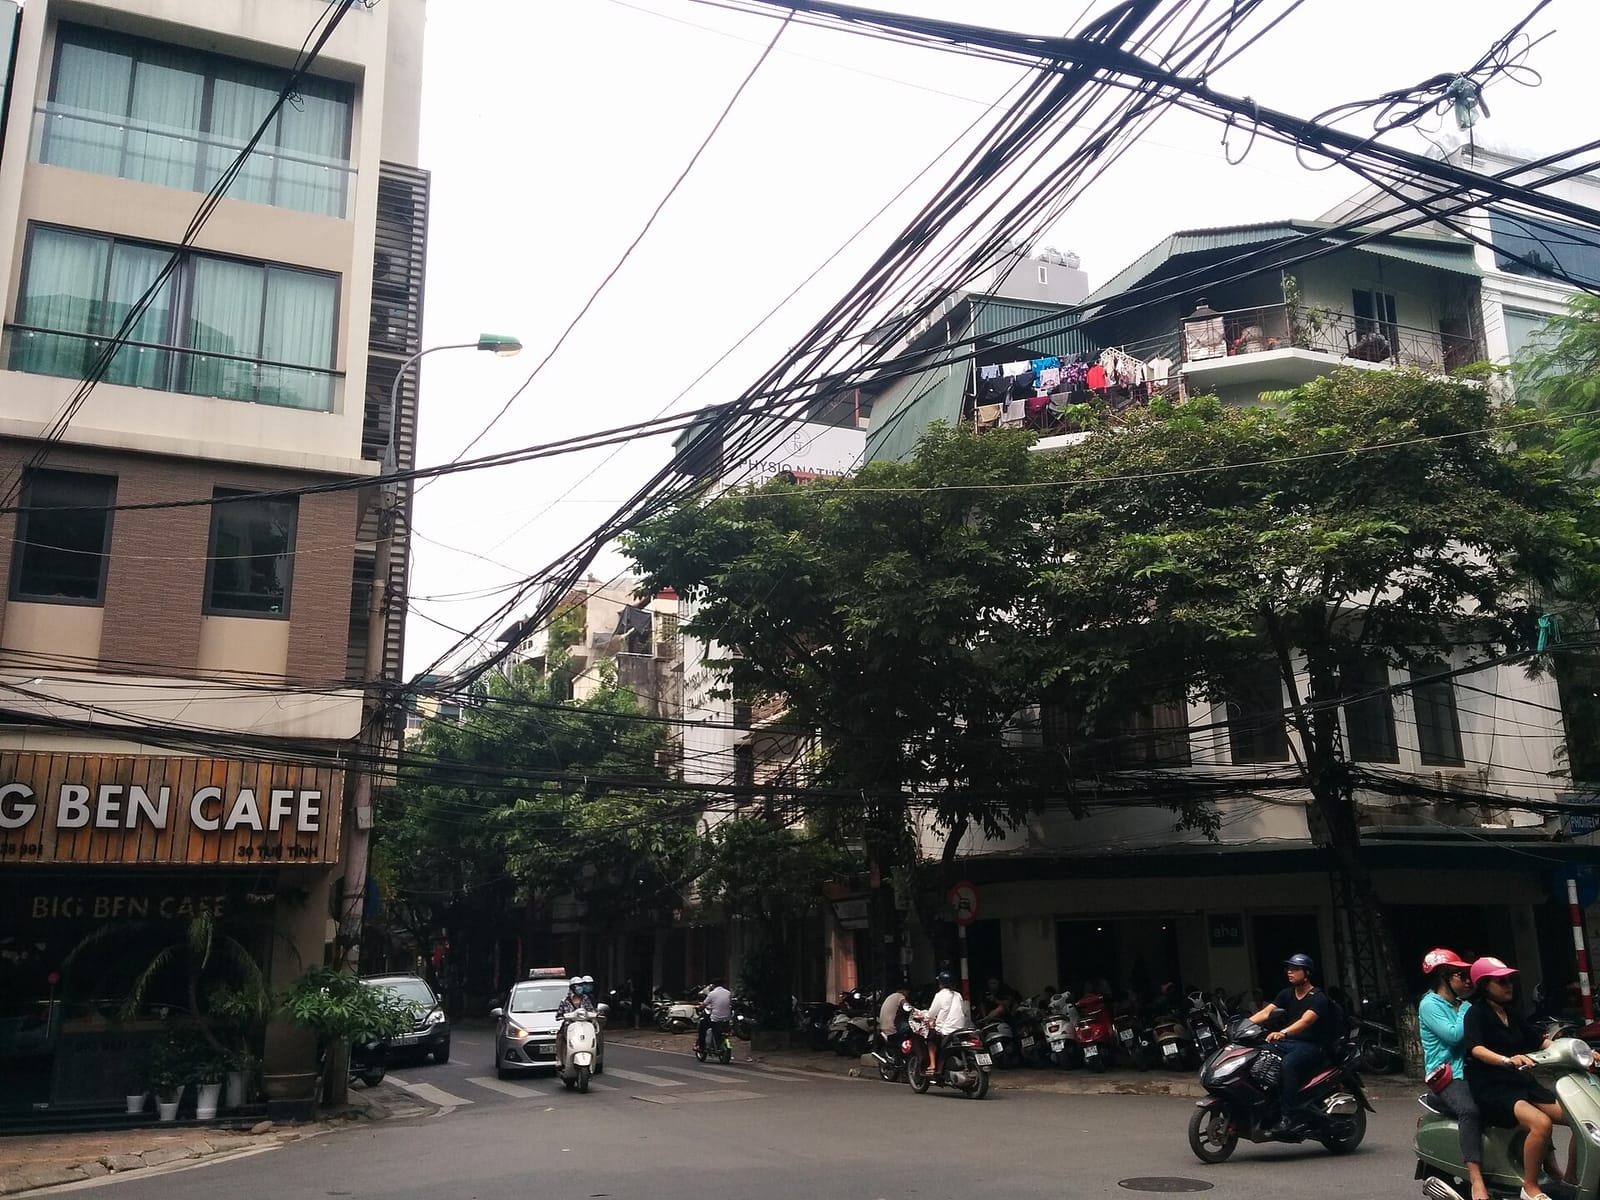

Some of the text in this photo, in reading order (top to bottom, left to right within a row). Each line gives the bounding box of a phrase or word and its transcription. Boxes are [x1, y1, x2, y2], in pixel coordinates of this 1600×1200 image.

[56, 784, 170, 829] BEN
[190, 786, 321, 832] CAFE
[32, 896, 83, 918] BIG
[160, 896, 224, 918] CAFE
